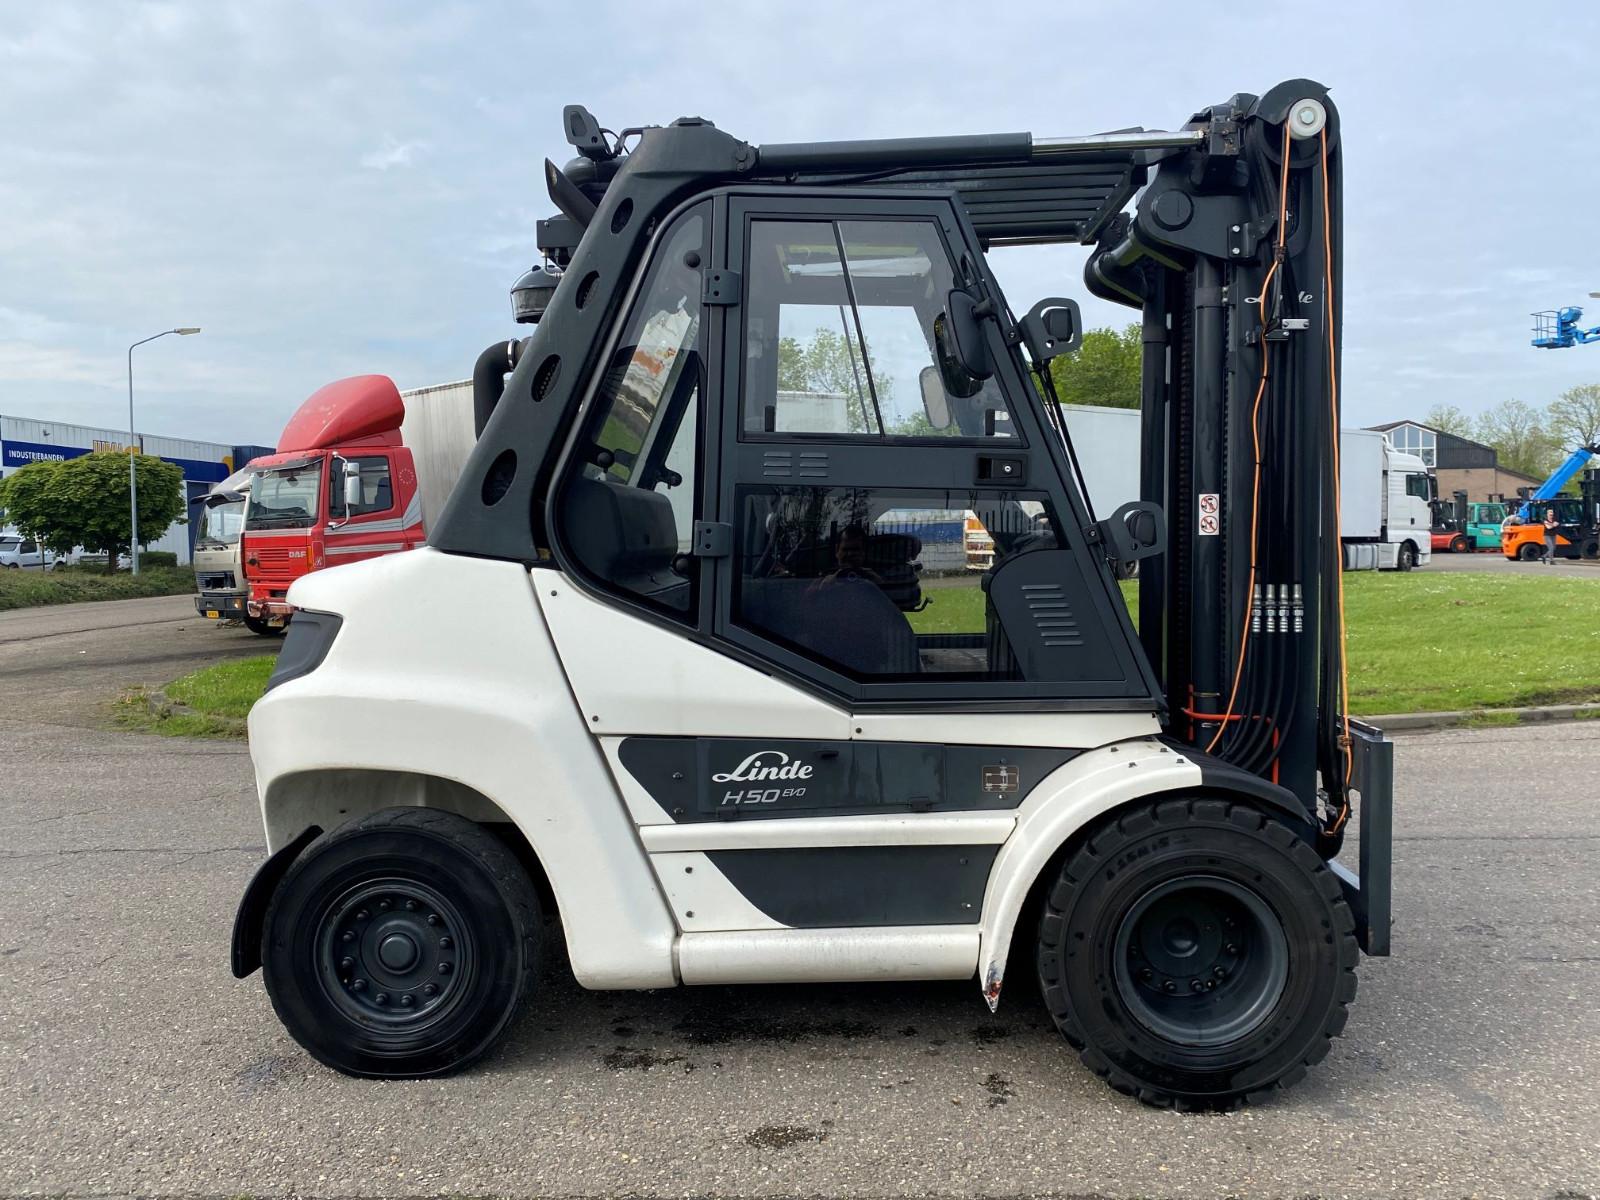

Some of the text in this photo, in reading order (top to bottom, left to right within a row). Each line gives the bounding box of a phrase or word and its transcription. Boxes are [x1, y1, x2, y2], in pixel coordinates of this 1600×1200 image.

[9, 450, 65, 462] INDUSTRIEBANDEN
[712, 751, 813, 782] Linde
[782, 787, 806, 797] EVO
